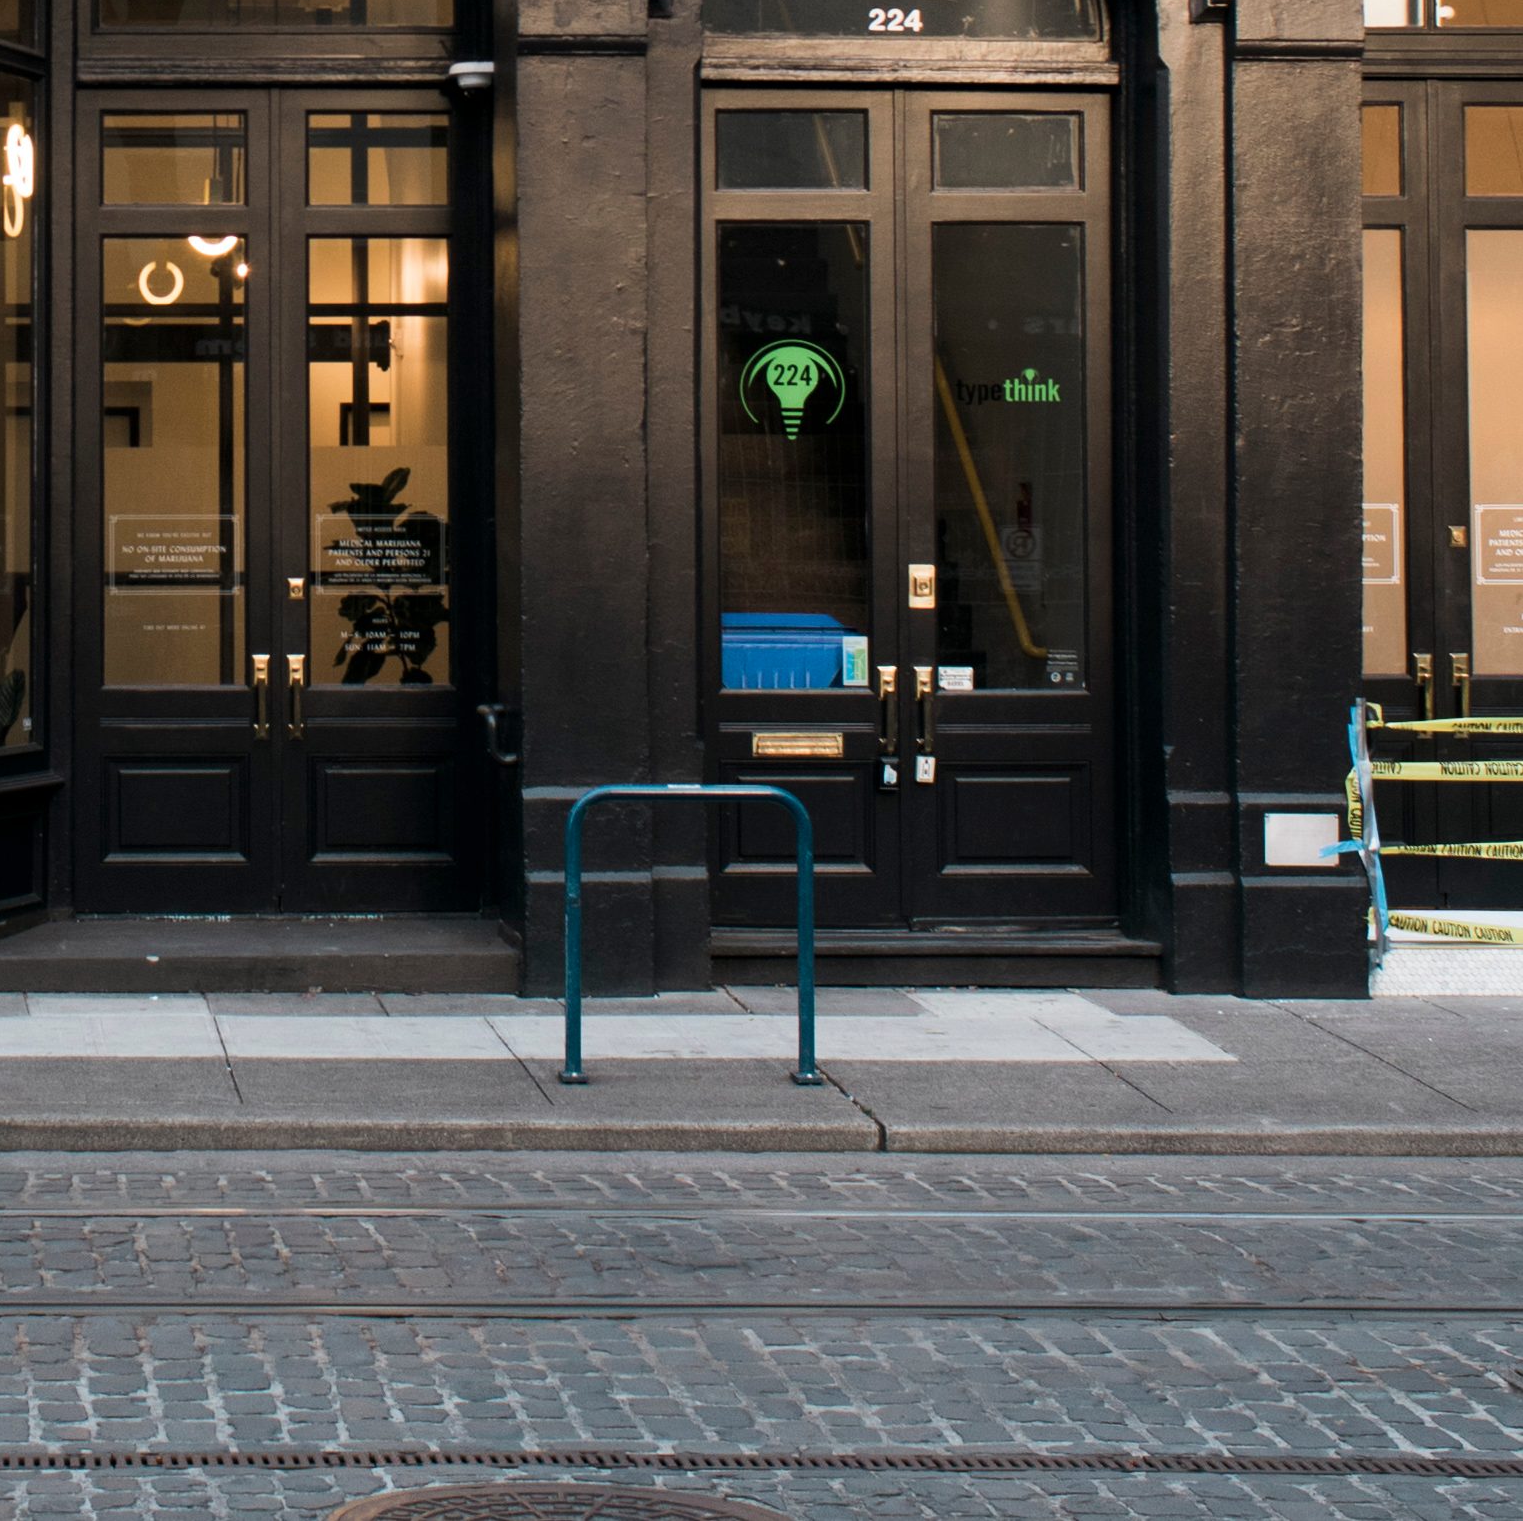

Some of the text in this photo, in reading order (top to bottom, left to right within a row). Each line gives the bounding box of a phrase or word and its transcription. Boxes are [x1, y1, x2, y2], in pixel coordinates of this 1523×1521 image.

[868, 7, 923, 32] 224
[772, 364, 812, 387] 224
[955, 375, 1061, 405] typethink
[122, 545, 134, 553] NO
[169, 545, 227, 553] CONSUMPTION
[339, 539, 421, 548] MEDICAL MARIJUANA
[328, 549, 364, 557] PATIENTS
[366, 549, 384, 557] AND
[385, 549, 420, 557] PERSONS
[145, 555, 204, 563] OF MARIJUANA
[335, 558, 426, 566] AND OLDER PERMITTED
[365, 631, 387, 639] 10AM
[400, 631, 420, 639] 10PM
[1440, 762, 1480, 776] CAUTION
[1441, 844, 1482, 857] CAUTION
[1389, 914, 1515, 943] CAUTION CAUTION CAUTION
